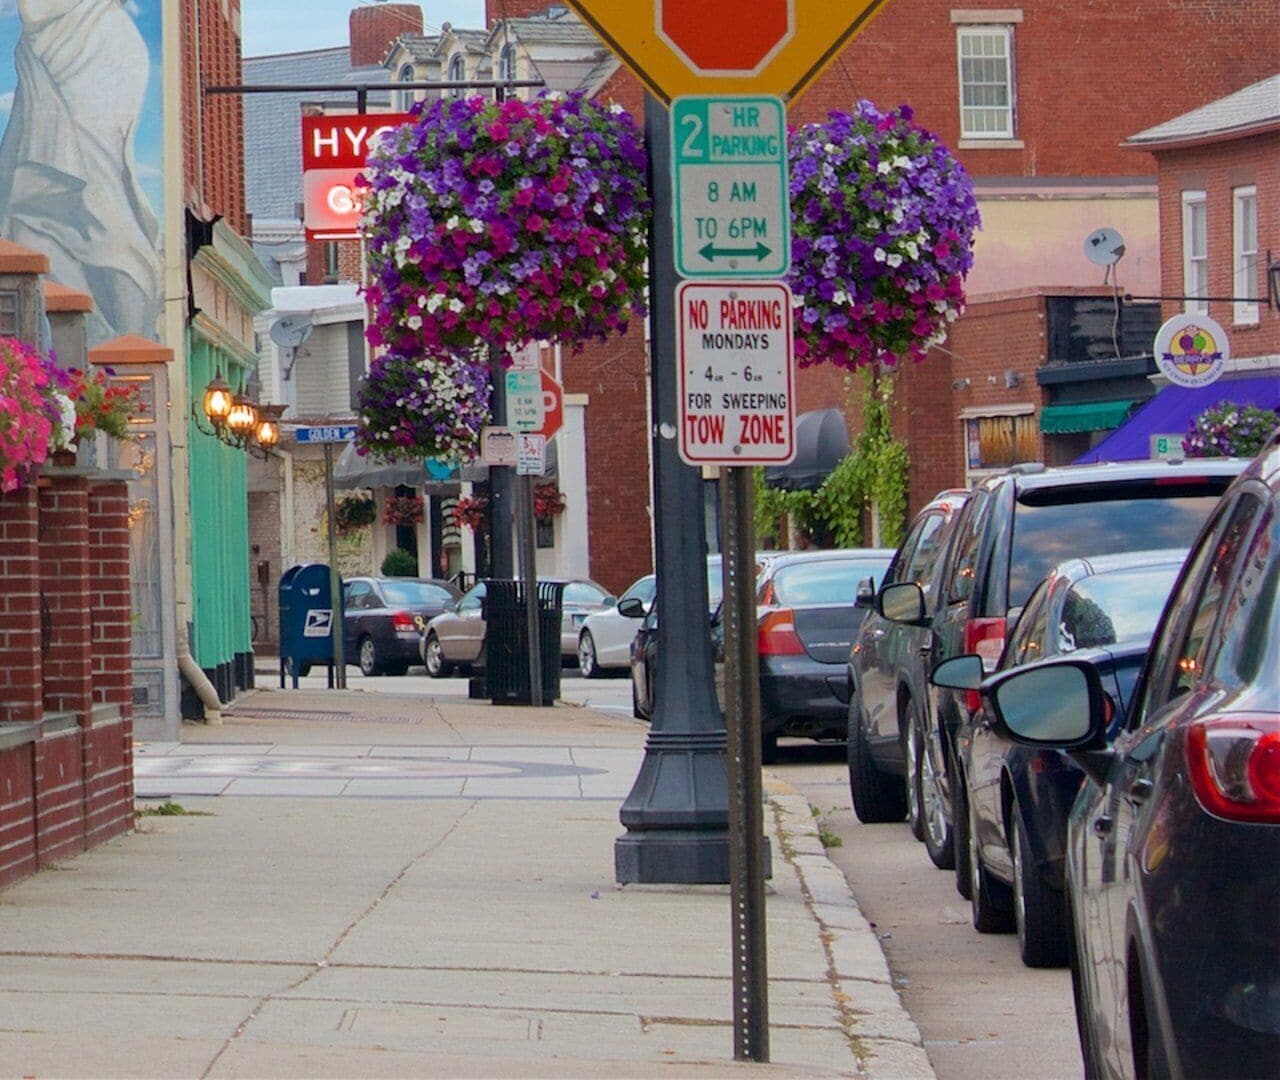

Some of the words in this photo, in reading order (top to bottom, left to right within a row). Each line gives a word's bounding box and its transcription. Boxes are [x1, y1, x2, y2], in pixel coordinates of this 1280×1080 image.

[681, 113, 704, 157] 2
[732, 107, 760, 128] HR
[712, 135, 778, 156] PARKING
[707, 181, 719, 203] 8
[729, 181, 757, 203] AM
[694, 217, 718, 239] TO
[728, 217, 767, 239] 6PM
[688, 300, 709, 330] NO
[720, 299, 782, 331] PARKING
[701, 333, 770, 351] MONDAYS
[688, 392, 712, 409] FOR
[722, 392, 787, 410] SWEEPING
[308, 427, 340, 441] GOLDEN
[688, 414, 725, 445] TOW
[739, 414, 785, 445] ZONE
